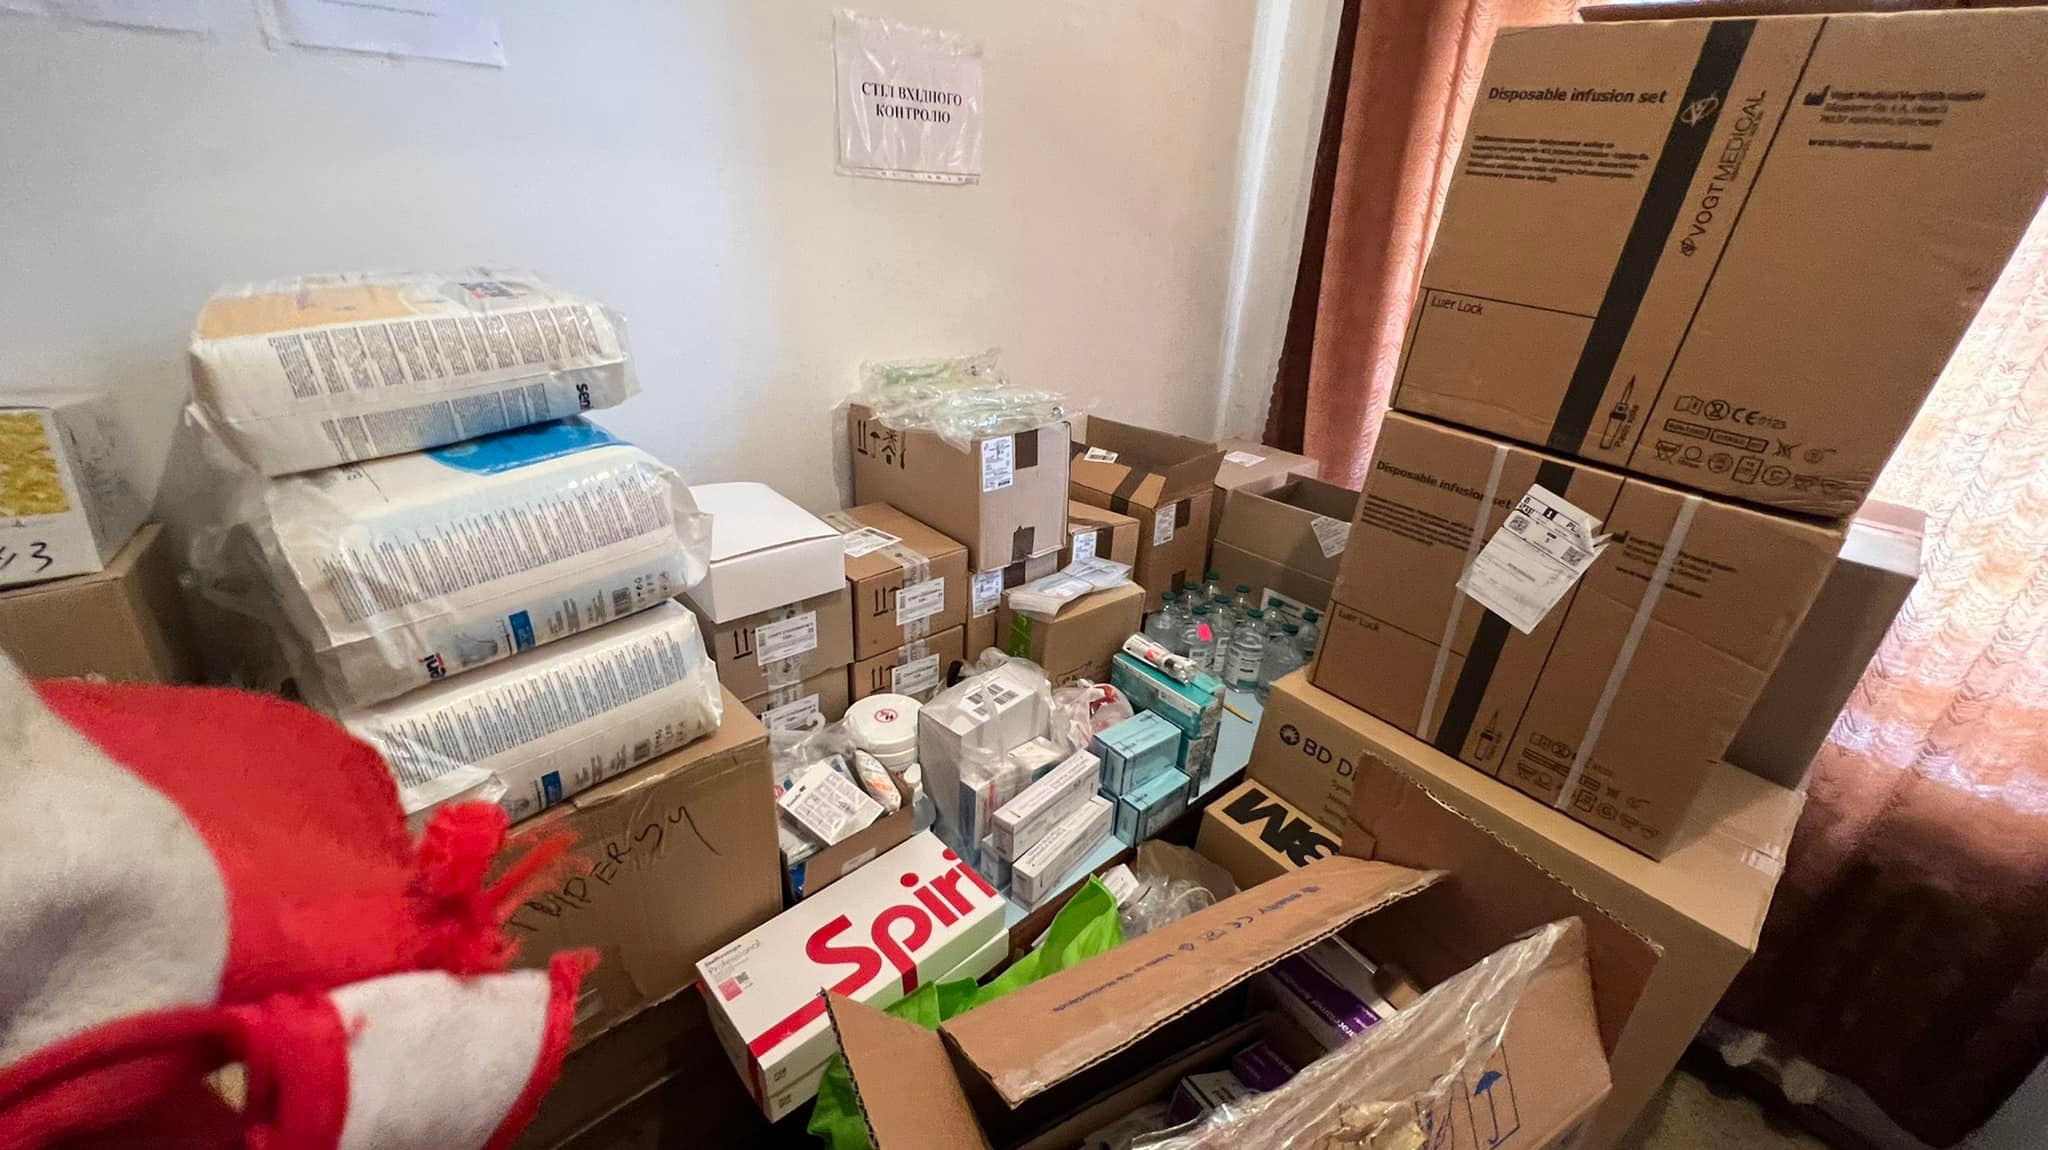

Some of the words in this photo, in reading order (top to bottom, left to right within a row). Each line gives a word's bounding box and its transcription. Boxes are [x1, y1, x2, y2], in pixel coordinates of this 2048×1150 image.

[861, 81, 894, 98] СТІЛ
[898, 87, 962, 106] ВХІДНОГО
[1488, 87, 1567, 103] Disposable
[1570, 88, 1634, 103] infusion
[1637, 89, 1668, 104] set
[876, 103, 951, 123] КОНТРОЛЮ
[1689, 183, 1725, 238] VOGT
[1713, 89, 1767, 182] MEDICAL
[1431, 296, 1457, 310] Luer
[1457, 300, 1484, 316] Lock
[1376, 460, 1438, 488] Disposable
[418, 652, 447, 679] eni
[1302, 738, 1333, 764] BD
[1336, 757, 1359, 782] Di
